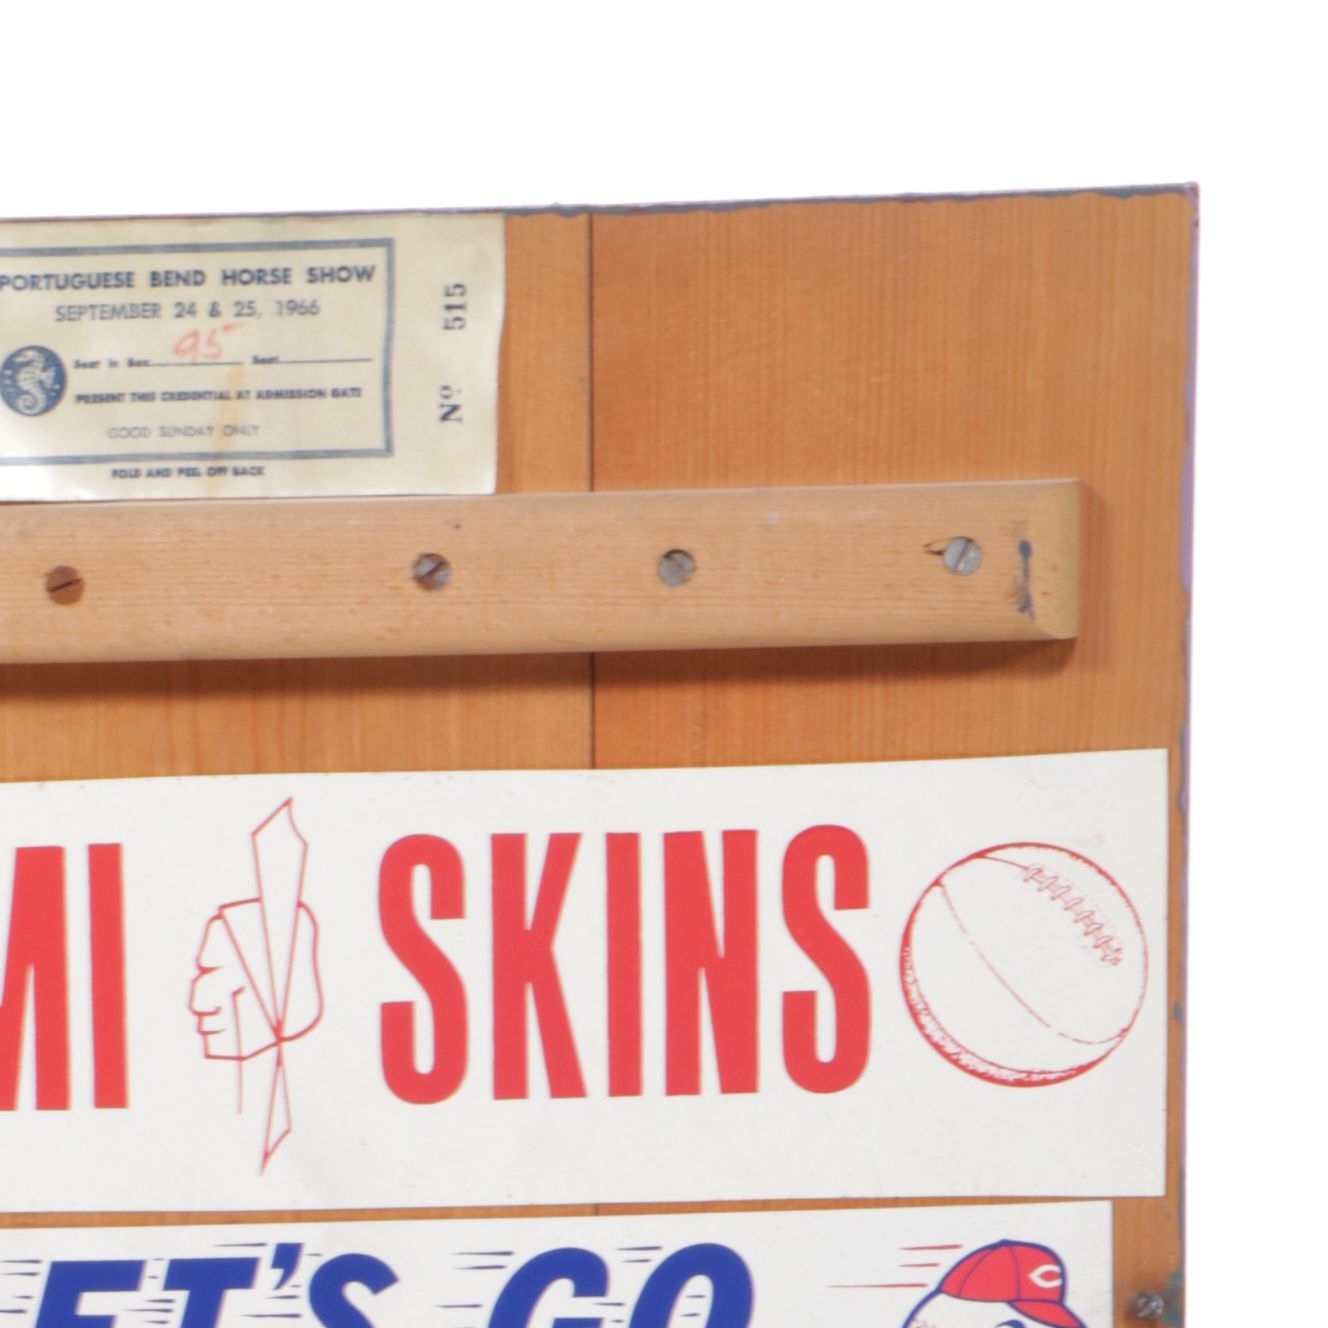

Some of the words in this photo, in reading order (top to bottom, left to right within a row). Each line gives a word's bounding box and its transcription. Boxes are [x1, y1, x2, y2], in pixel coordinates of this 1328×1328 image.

[150, 269, 205, 288] BEND
[222, 268, 291, 286] HORSE
[306, 265, 376, 284] SHOW
[55, 303, 161, 322] SEPTEMBER
[174, 301, 197, 318] 24
[208, 301, 222, 318] &
[233, 300, 262, 319] 25,
[275, 299, 320, 317] 1966
[441, 282, 468, 331] 515
[74, 392, 125, 405] PRESENT
[130, 391, 156, 402] THIS
[161, 390, 232, 402] CREDENTIAL
[236, 389, 251, 400] AT
[256, 388, 327, 400] ADMISSION
[331, 386, 362, 398] GATE
[107, 425, 151, 439] GOOD
[159, 424, 215, 438] SUNDAY
[223, 424, 261, 437] ONLY
[232, 465, 266, 477] BACK
[378, 824, 871, 1104] SKINS
